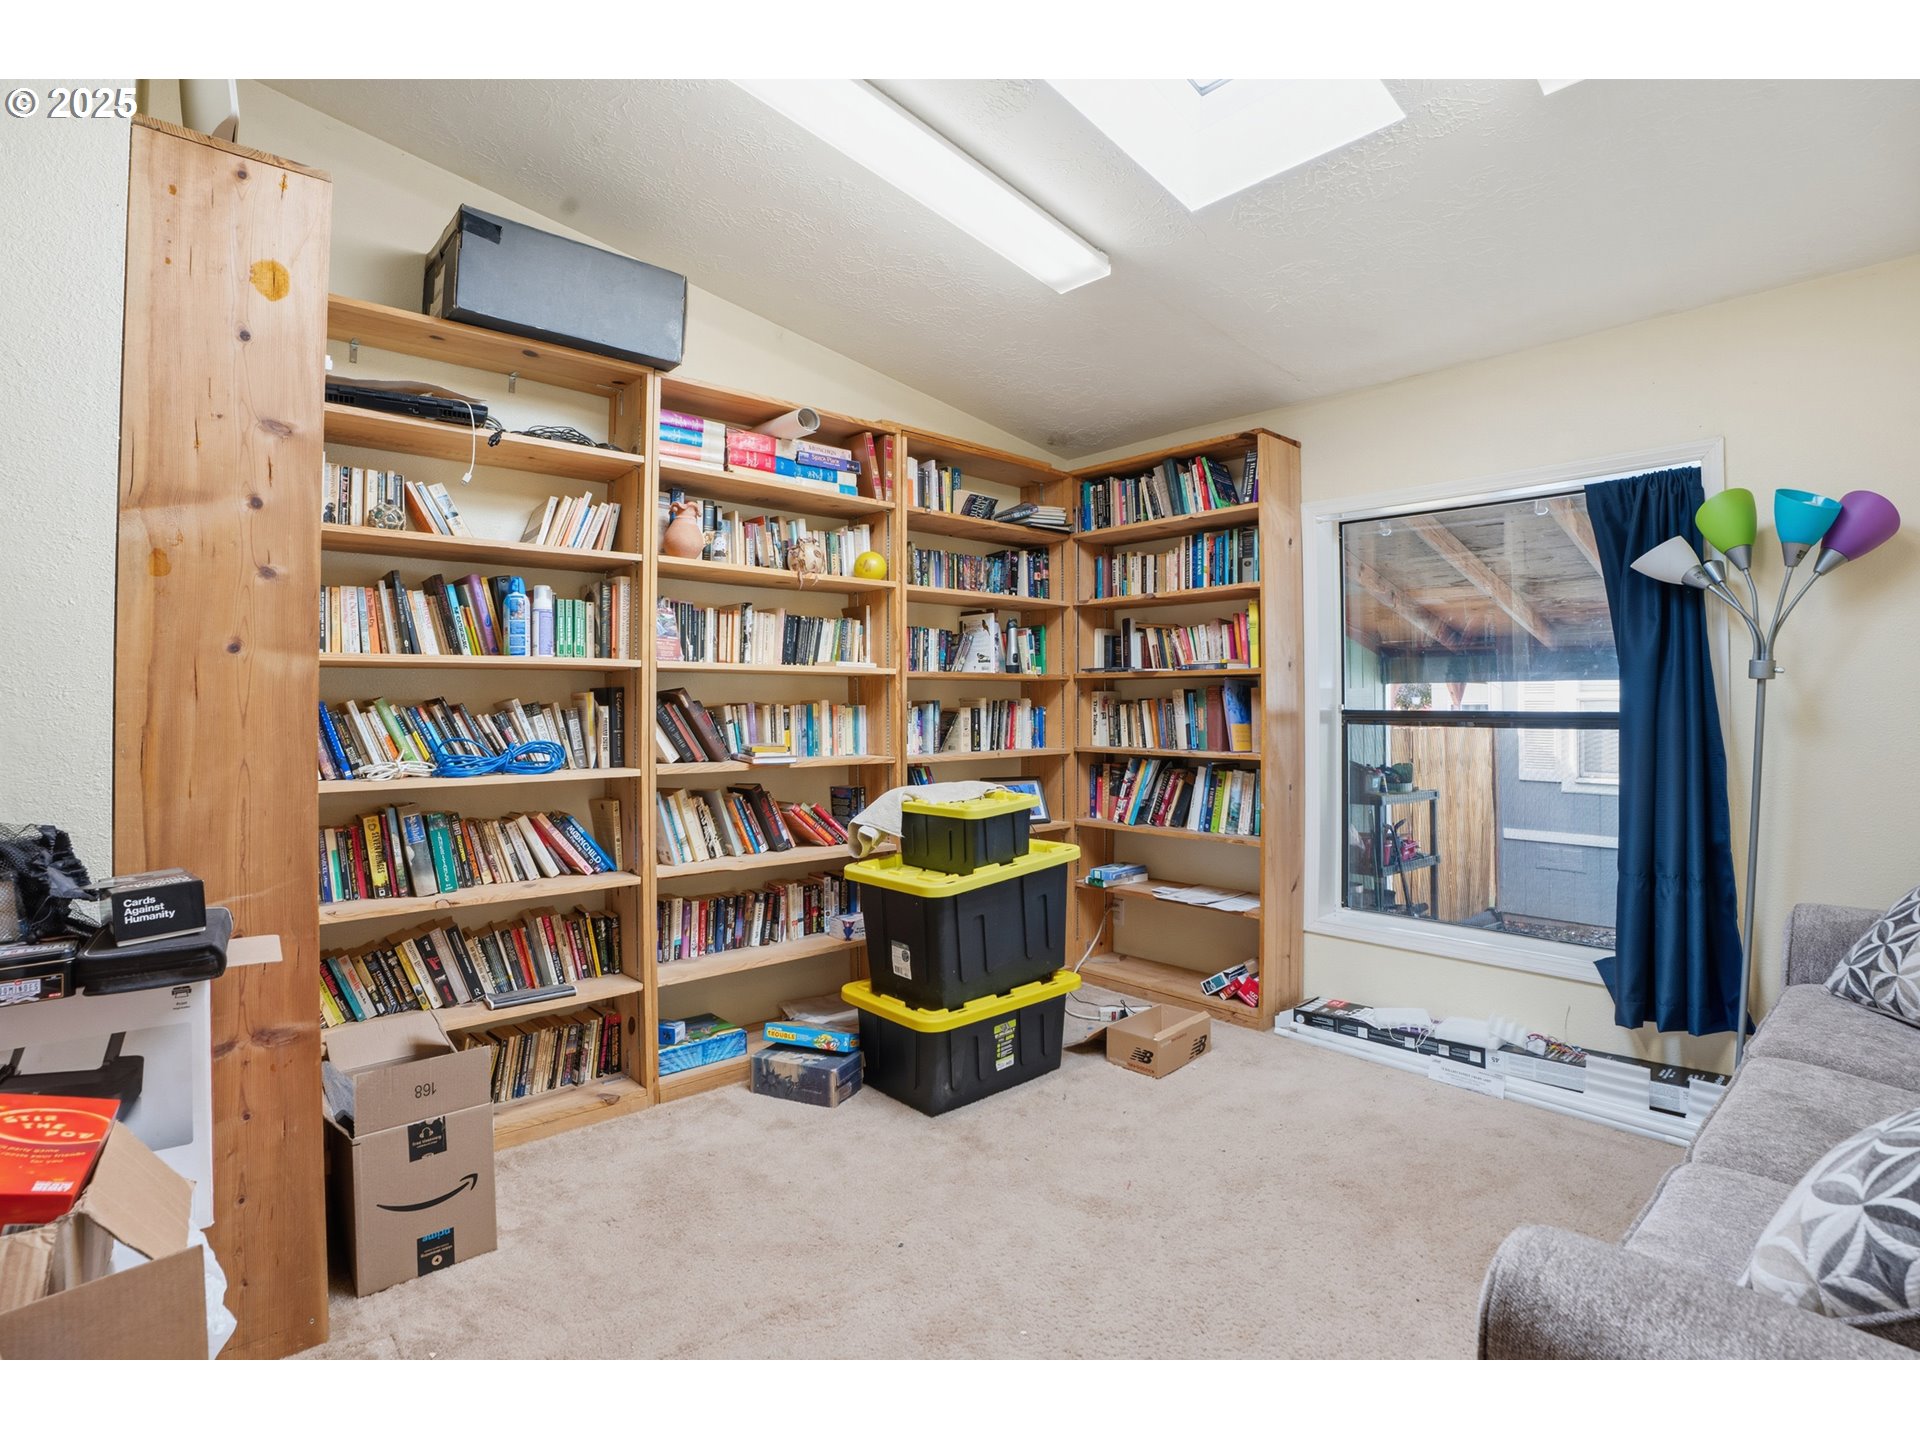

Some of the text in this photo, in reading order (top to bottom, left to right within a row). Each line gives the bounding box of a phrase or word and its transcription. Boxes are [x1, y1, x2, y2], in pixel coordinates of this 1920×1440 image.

[123, 896, 156, 908] Cards
[124, 902, 165, 916] Against
[124, 910, 176, 924] Humanity
[0, 983, 38, 996] OMINOES
[414, 1082, 436, 1098] 168
